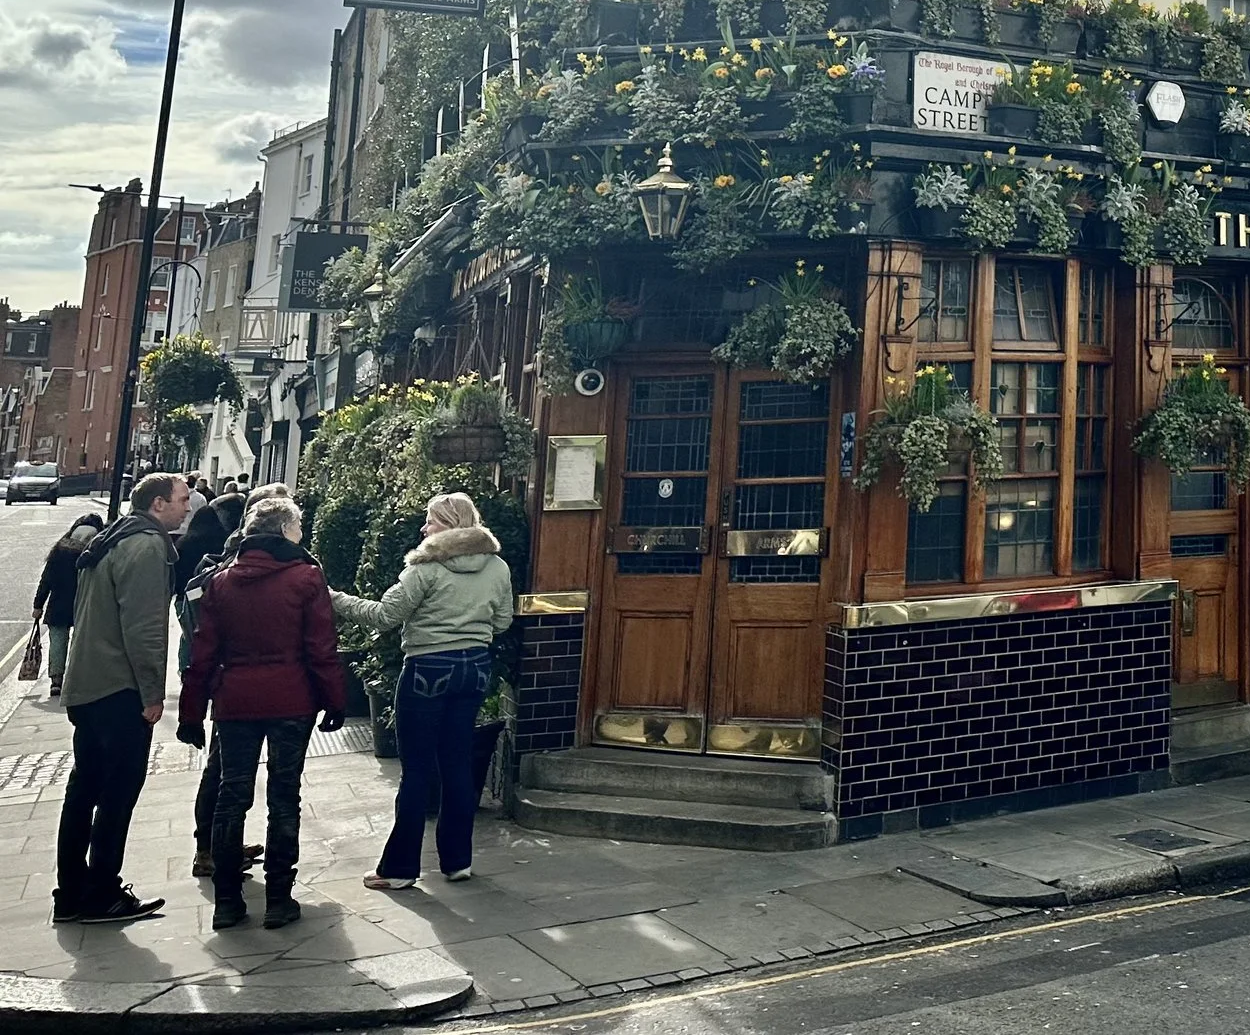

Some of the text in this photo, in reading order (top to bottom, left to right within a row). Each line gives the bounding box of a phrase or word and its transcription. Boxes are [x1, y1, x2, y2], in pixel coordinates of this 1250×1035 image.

[918, 57, 994, 76] The Royal Borough of
[295, 269, 316, 278] THE
[293, 287, 317, 296] DEN
